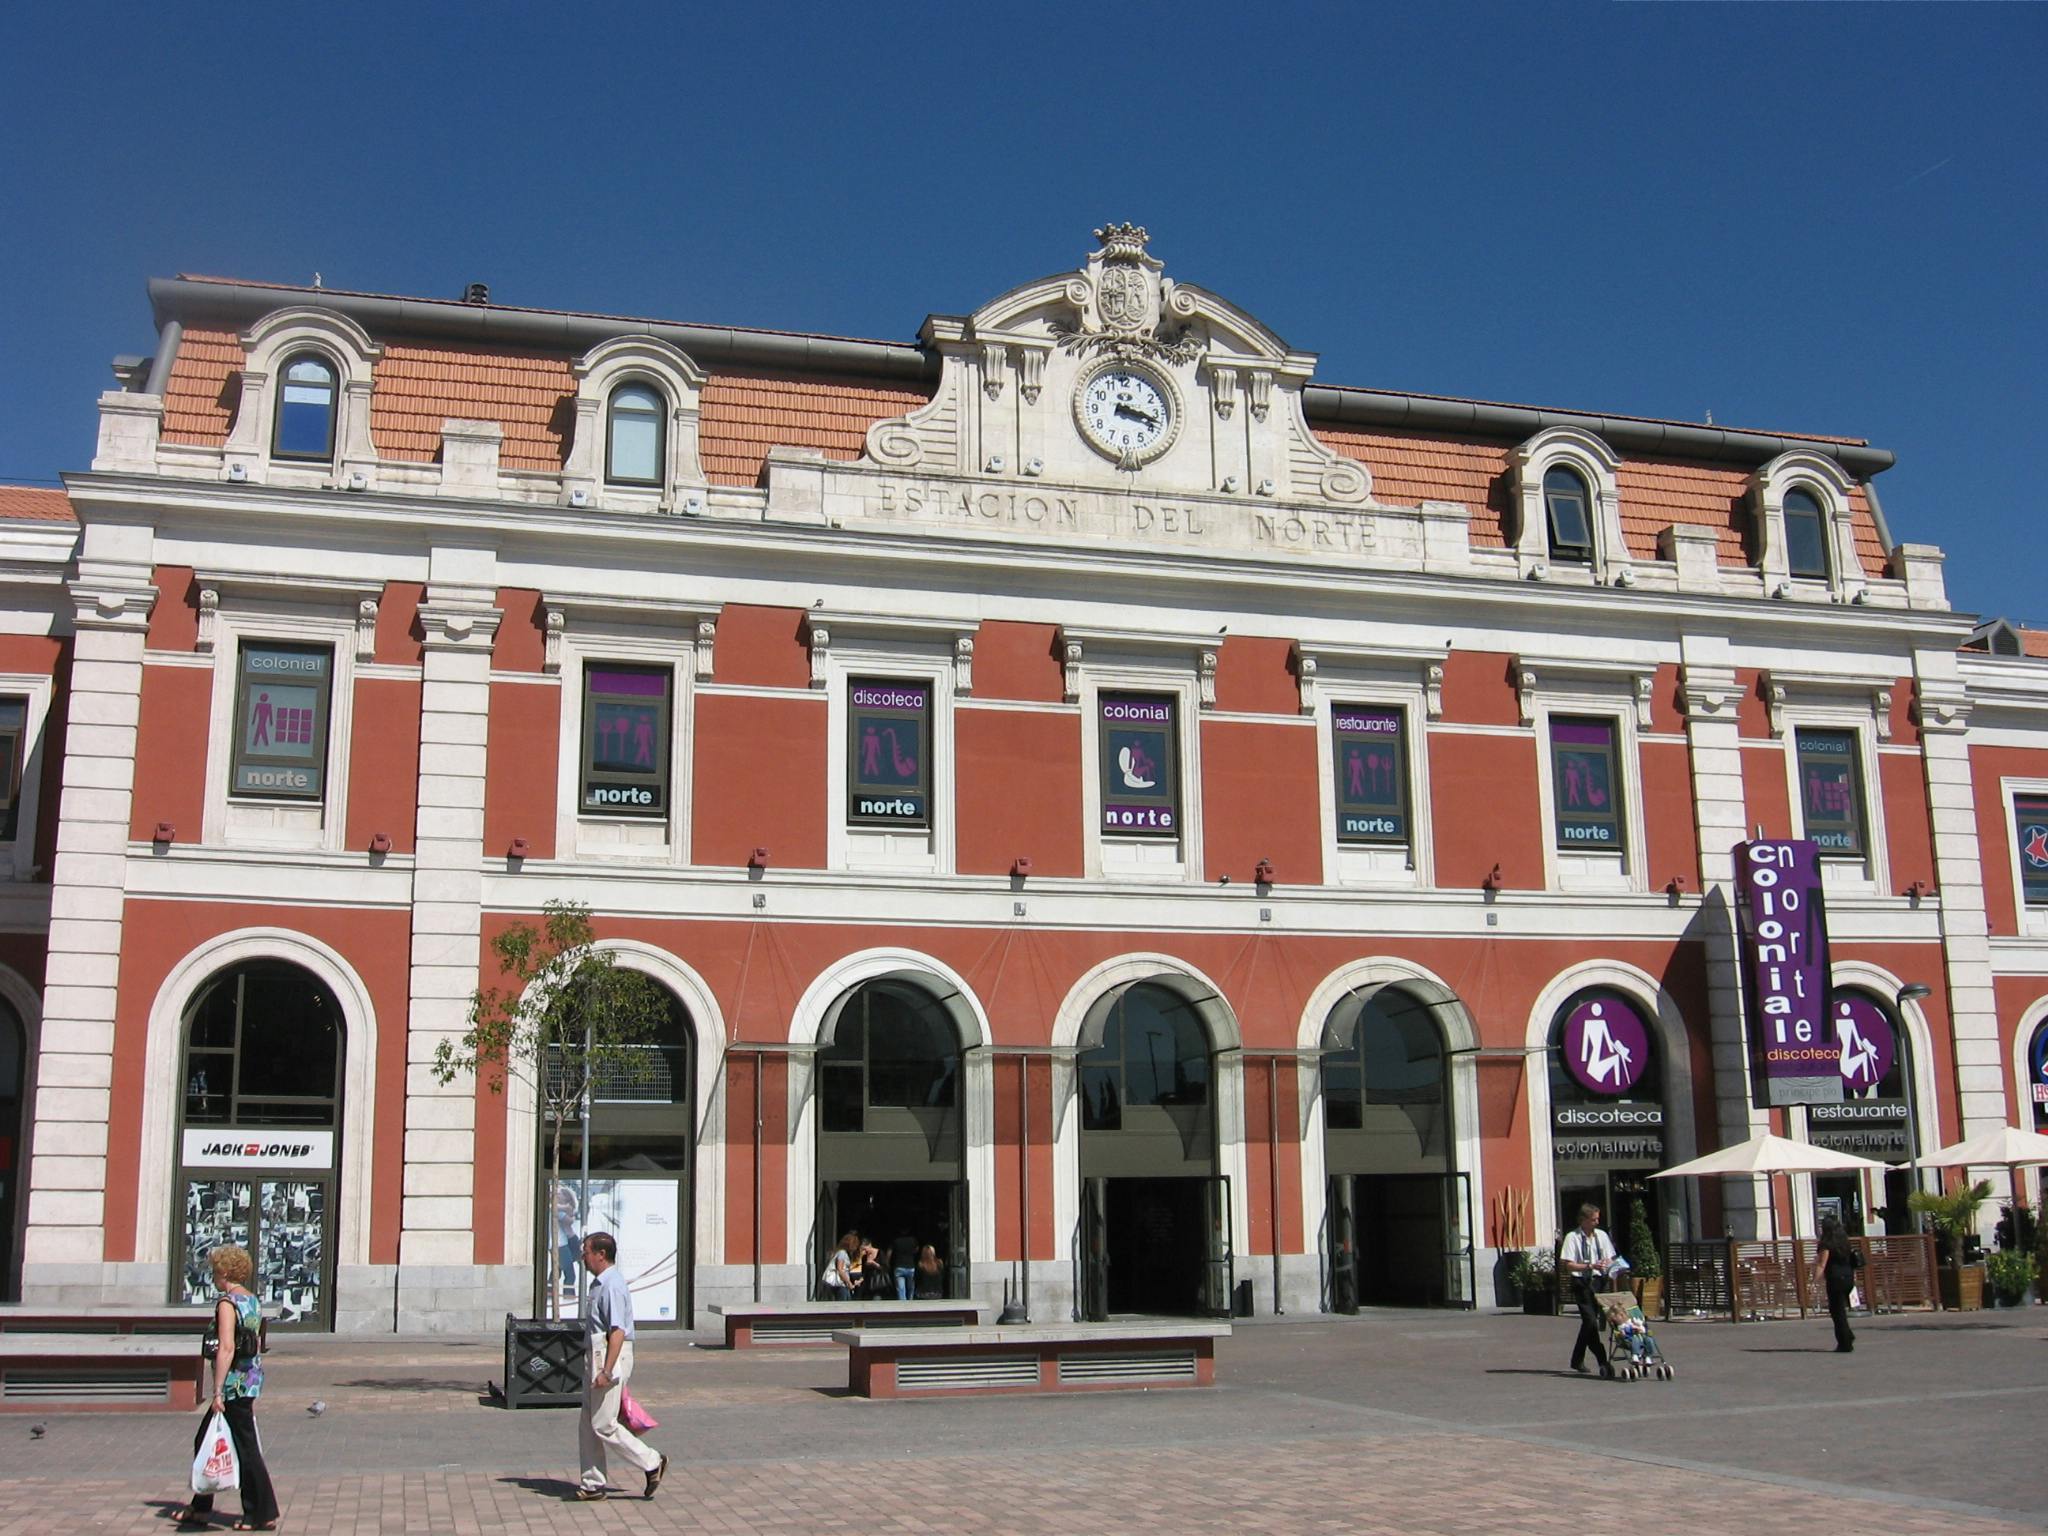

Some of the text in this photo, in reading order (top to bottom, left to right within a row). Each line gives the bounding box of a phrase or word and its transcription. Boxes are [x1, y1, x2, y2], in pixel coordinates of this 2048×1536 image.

[1105, 380, 1115, 391] 11
[1136, 383, 1141, 393] 1
[1095, 390, 1106, 401] 10
[1147, 393, 1154, 404] 2
[1091, 403, 1099, 414] 9
[1152, 408, 1159, 419] 3
[1096, 419, 1103, 429] 8
[1108, 429, 1116, 440] 7
[1122, 434, 1130, 445] 6
[1137, 432, 1145, 443] 5
[878, 484, 1377, 548] ESTACION DEL NORTE
[251, 656, 320, 671] colonial
[853, 690, 923, 708] discoteca
[1103, 704, 1169, 720] colonial
[1336, 716, 1397, 732] restaurante
[1799, 741, 1846, 752] colonial
[246, 770, 308, 787] norte
[594, 787, 653, 804] norte
[860, 799, 916, 815] norte
[1106, 809, 1172, 826] norte
[1346, 818, 1395, 833] norte
[1564, 826, 1610, 840] norte
[1767, 1048, 1840, 1061] discoteca
[1557, 1108, 1662, 1123] discoteca
[1812, 1103, 1907, 1118] restaurante
